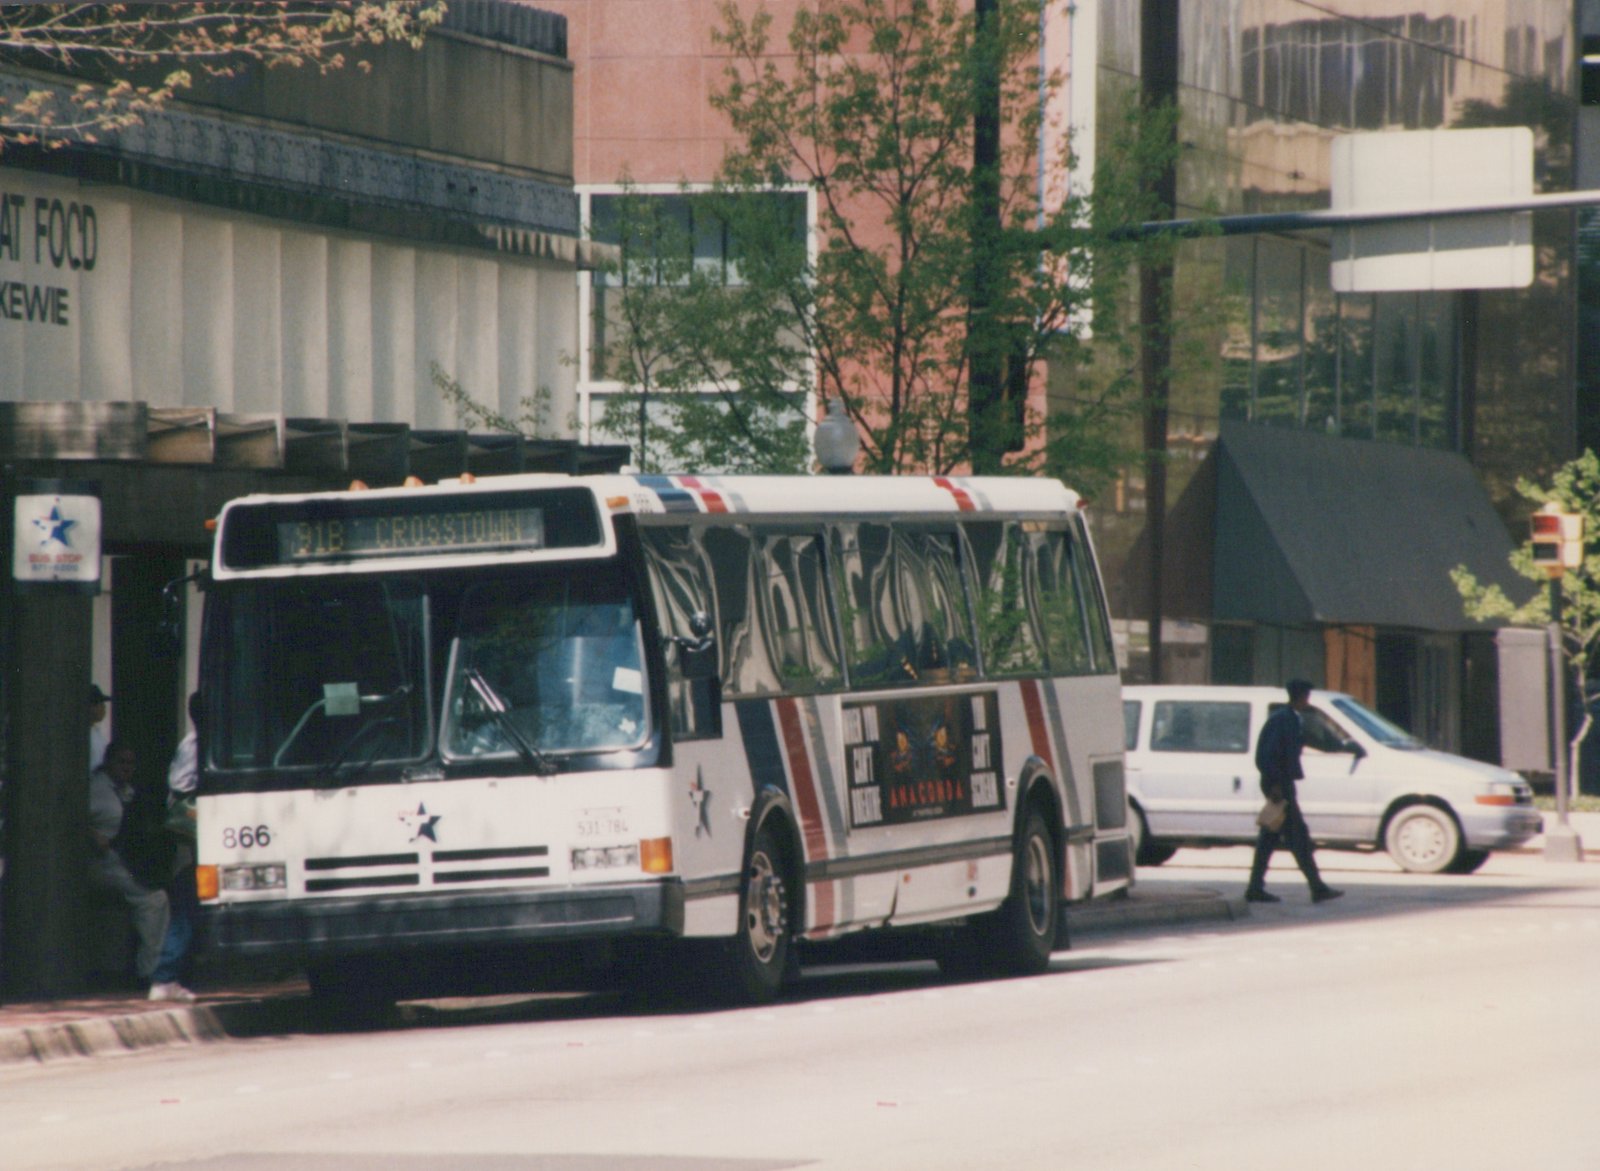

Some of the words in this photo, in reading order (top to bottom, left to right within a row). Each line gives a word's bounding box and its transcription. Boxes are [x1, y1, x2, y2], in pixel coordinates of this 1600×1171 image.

[375, 509, 522, 549] CROSSTOWN
[890, 778, 964, 809] ANACONDA
[222, 825, 272, 849] 866
